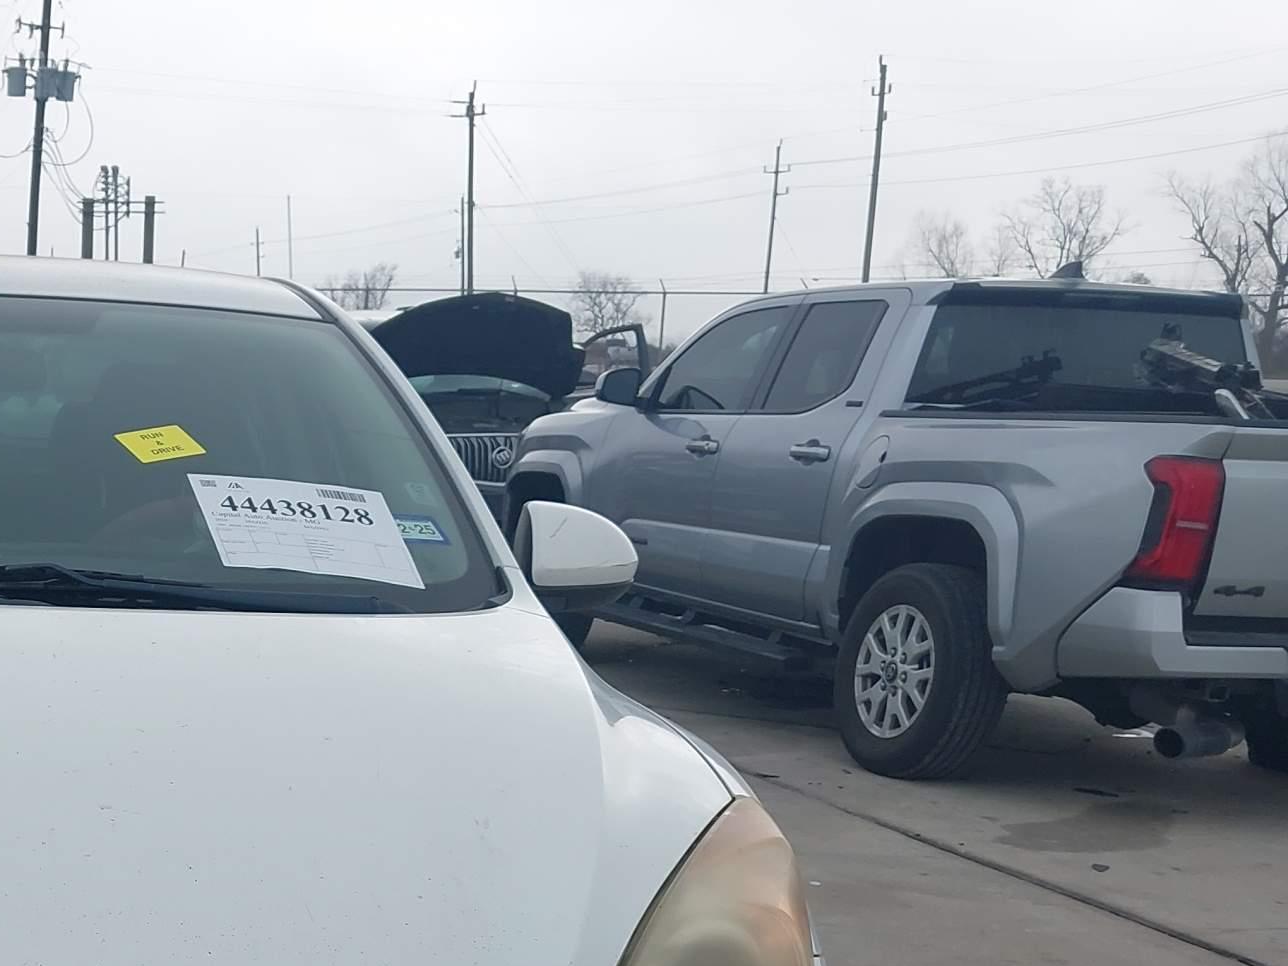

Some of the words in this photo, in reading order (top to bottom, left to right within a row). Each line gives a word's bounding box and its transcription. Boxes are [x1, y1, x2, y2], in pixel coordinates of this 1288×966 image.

[139, 431, 165, 441] RUN
[150, 445, 185, 456] DRIVE
[219, 494, 375, 527] 44438128
